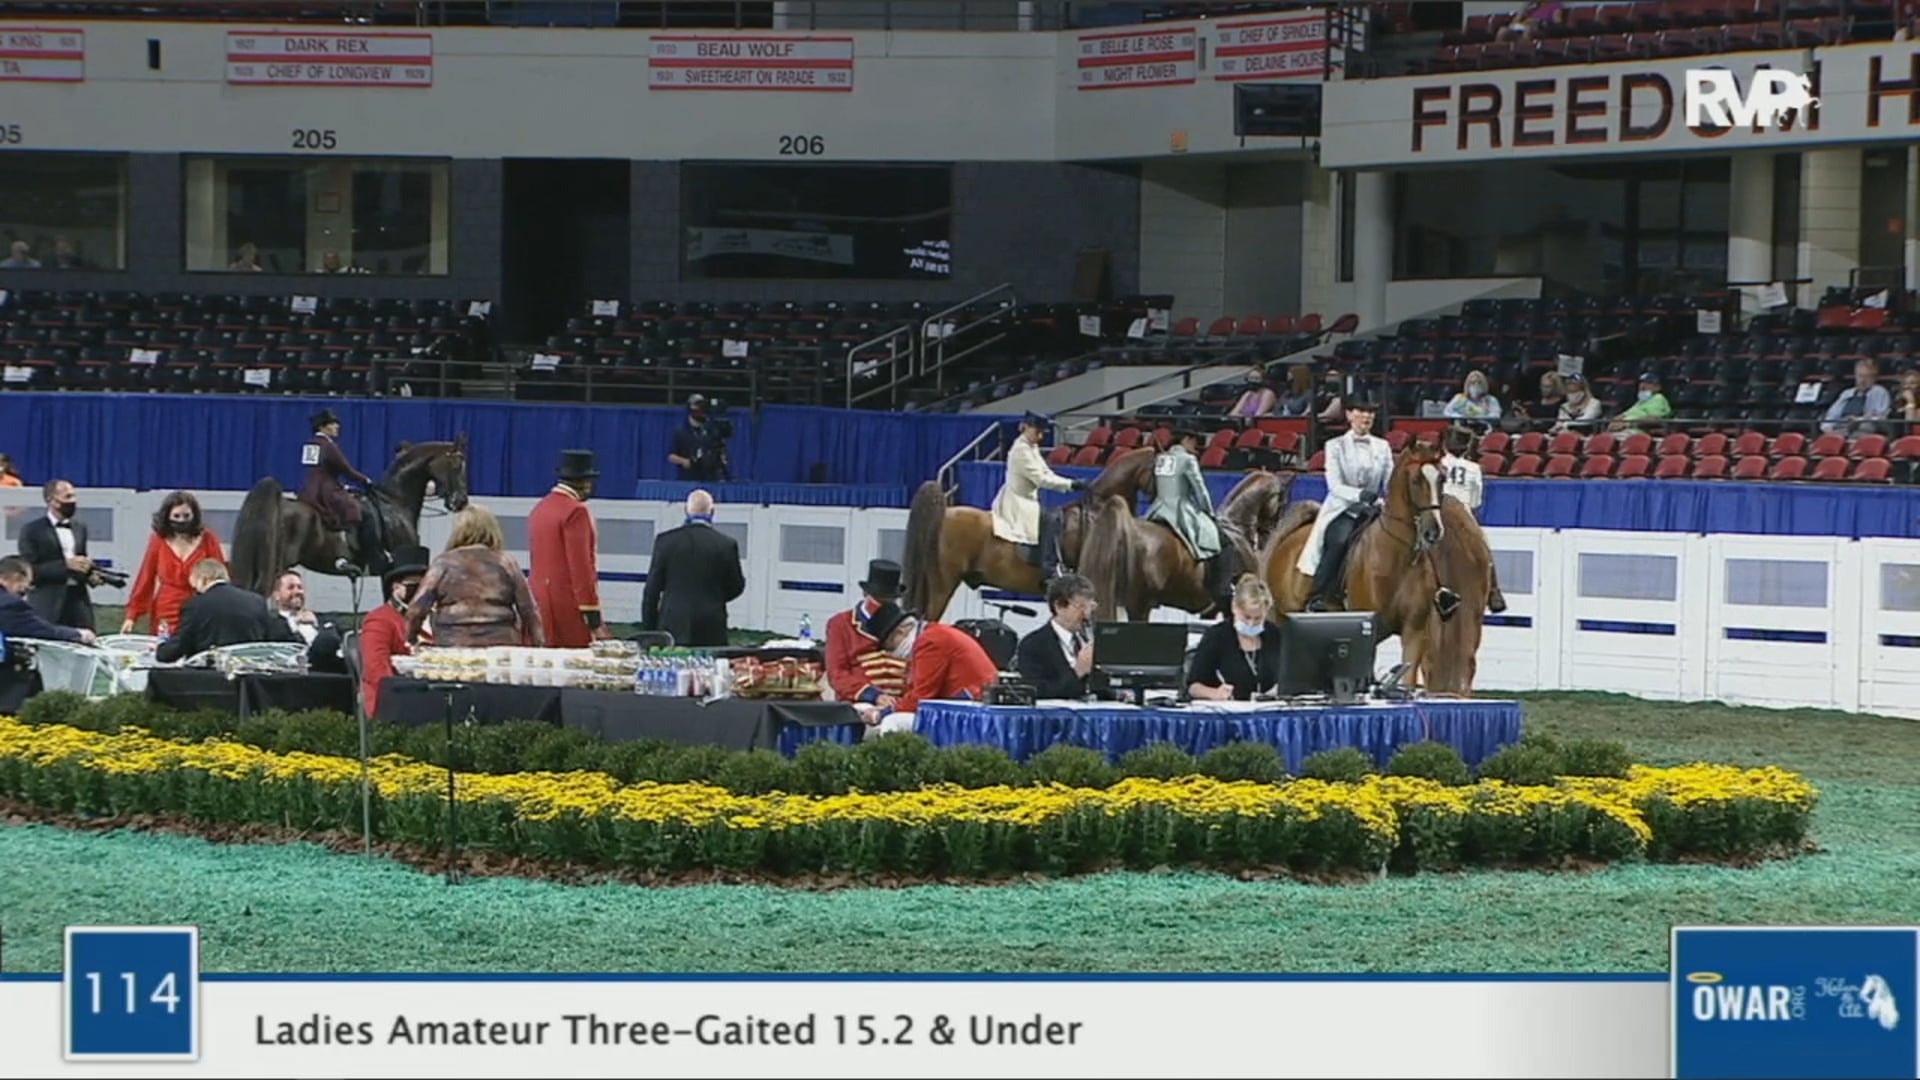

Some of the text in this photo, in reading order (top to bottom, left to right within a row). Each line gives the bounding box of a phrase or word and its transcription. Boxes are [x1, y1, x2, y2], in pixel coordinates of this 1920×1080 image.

[9, 34, 43, 48] KING
[1267, 26, 1279, 42] OF
[284, 37, 328, 52] DARK
[336, 38, 369, 53] REX
[697, 42, 741, 57] BEAU
[747, 42, 794, 57] WOLF
[1100, 39, 1129, 54] BELLE
[1132, 37, 1144, 52] LE
[1148, 34, 1175, 51] ROSE
[266, 63, 302, 79] CHIEF
[307, 64, 325, 79] OF
[329, 65, 393, 80] LONGVIEW
[685, 69, 752, 84] SWEETHEART
[756, 70, 773, 84] ON
[776, 70, 815, 84] PARADE
[1103, 66, 1133, 81] NIGHT
[1136, 63, 1177, 80] FLOWER
[292, 129, 336, 149] 205
[779, 135, 824, 155] 206
